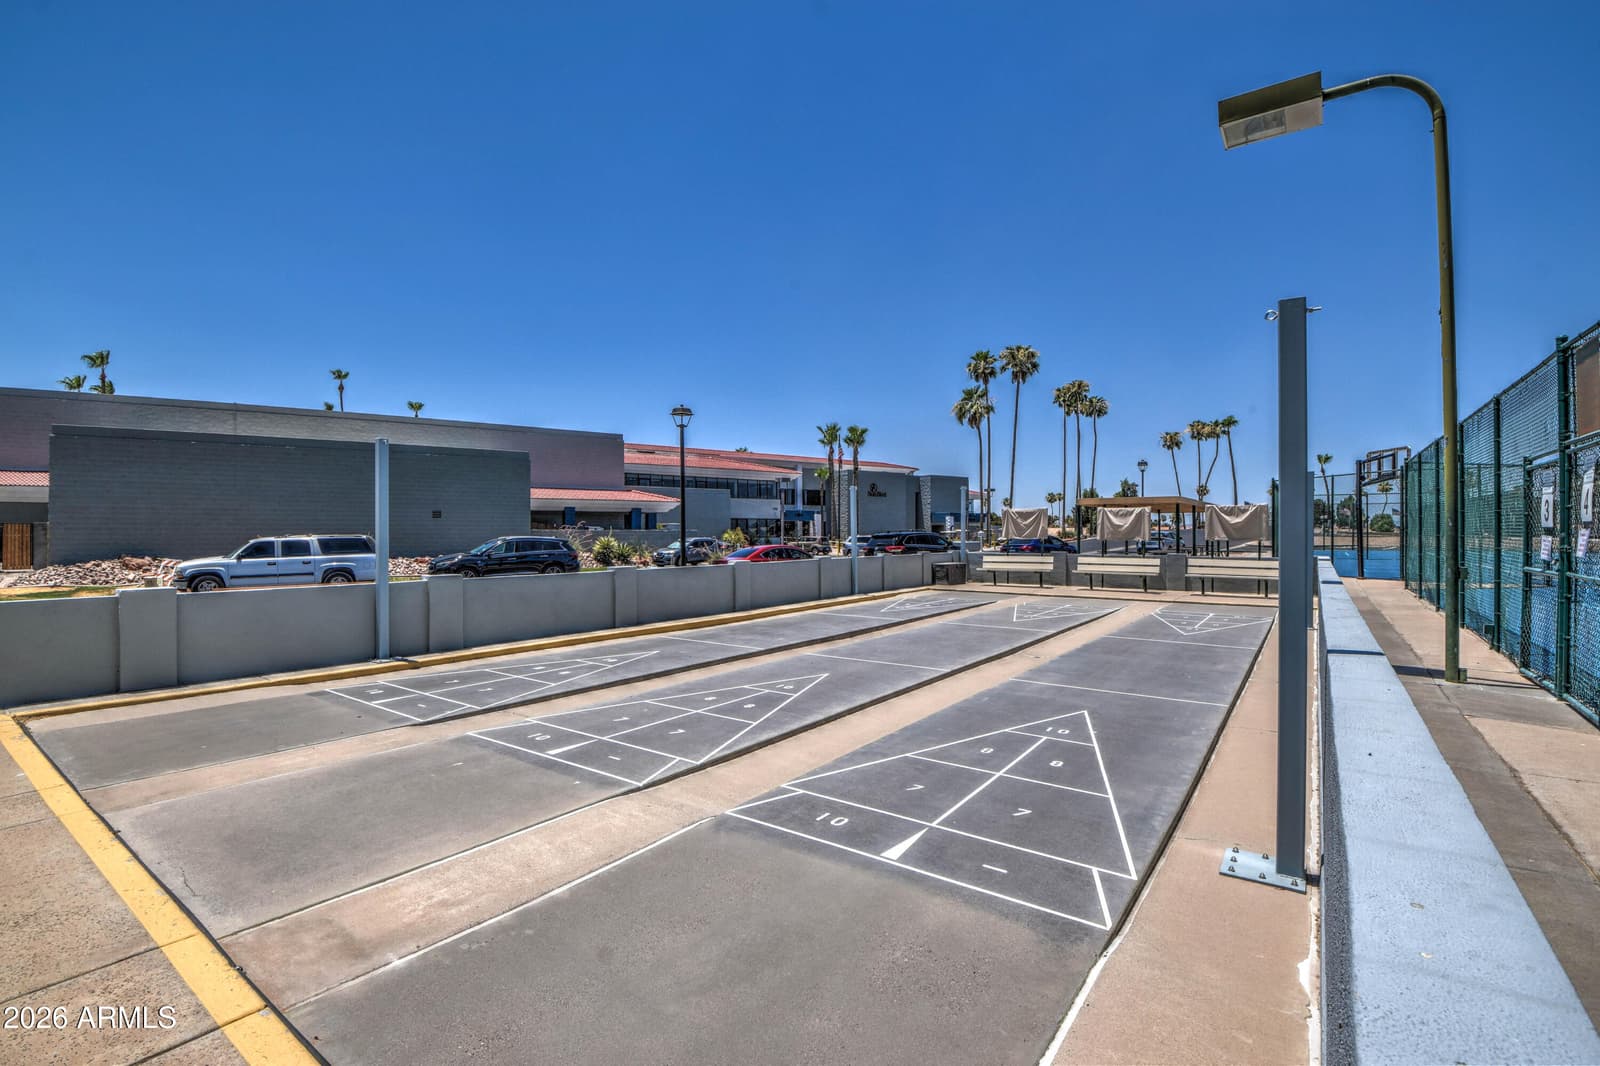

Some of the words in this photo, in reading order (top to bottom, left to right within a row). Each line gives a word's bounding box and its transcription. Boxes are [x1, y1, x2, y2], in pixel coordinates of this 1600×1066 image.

[1583, 488, 1590, 516] 4
[1544, 499, 1550, 522] 3
[527, 732, 552, 741] 10
[1046, 727, 1070, 735] 10
[1012, 807, 1032, 816] 7
[815, 812, 849, 826] 10
